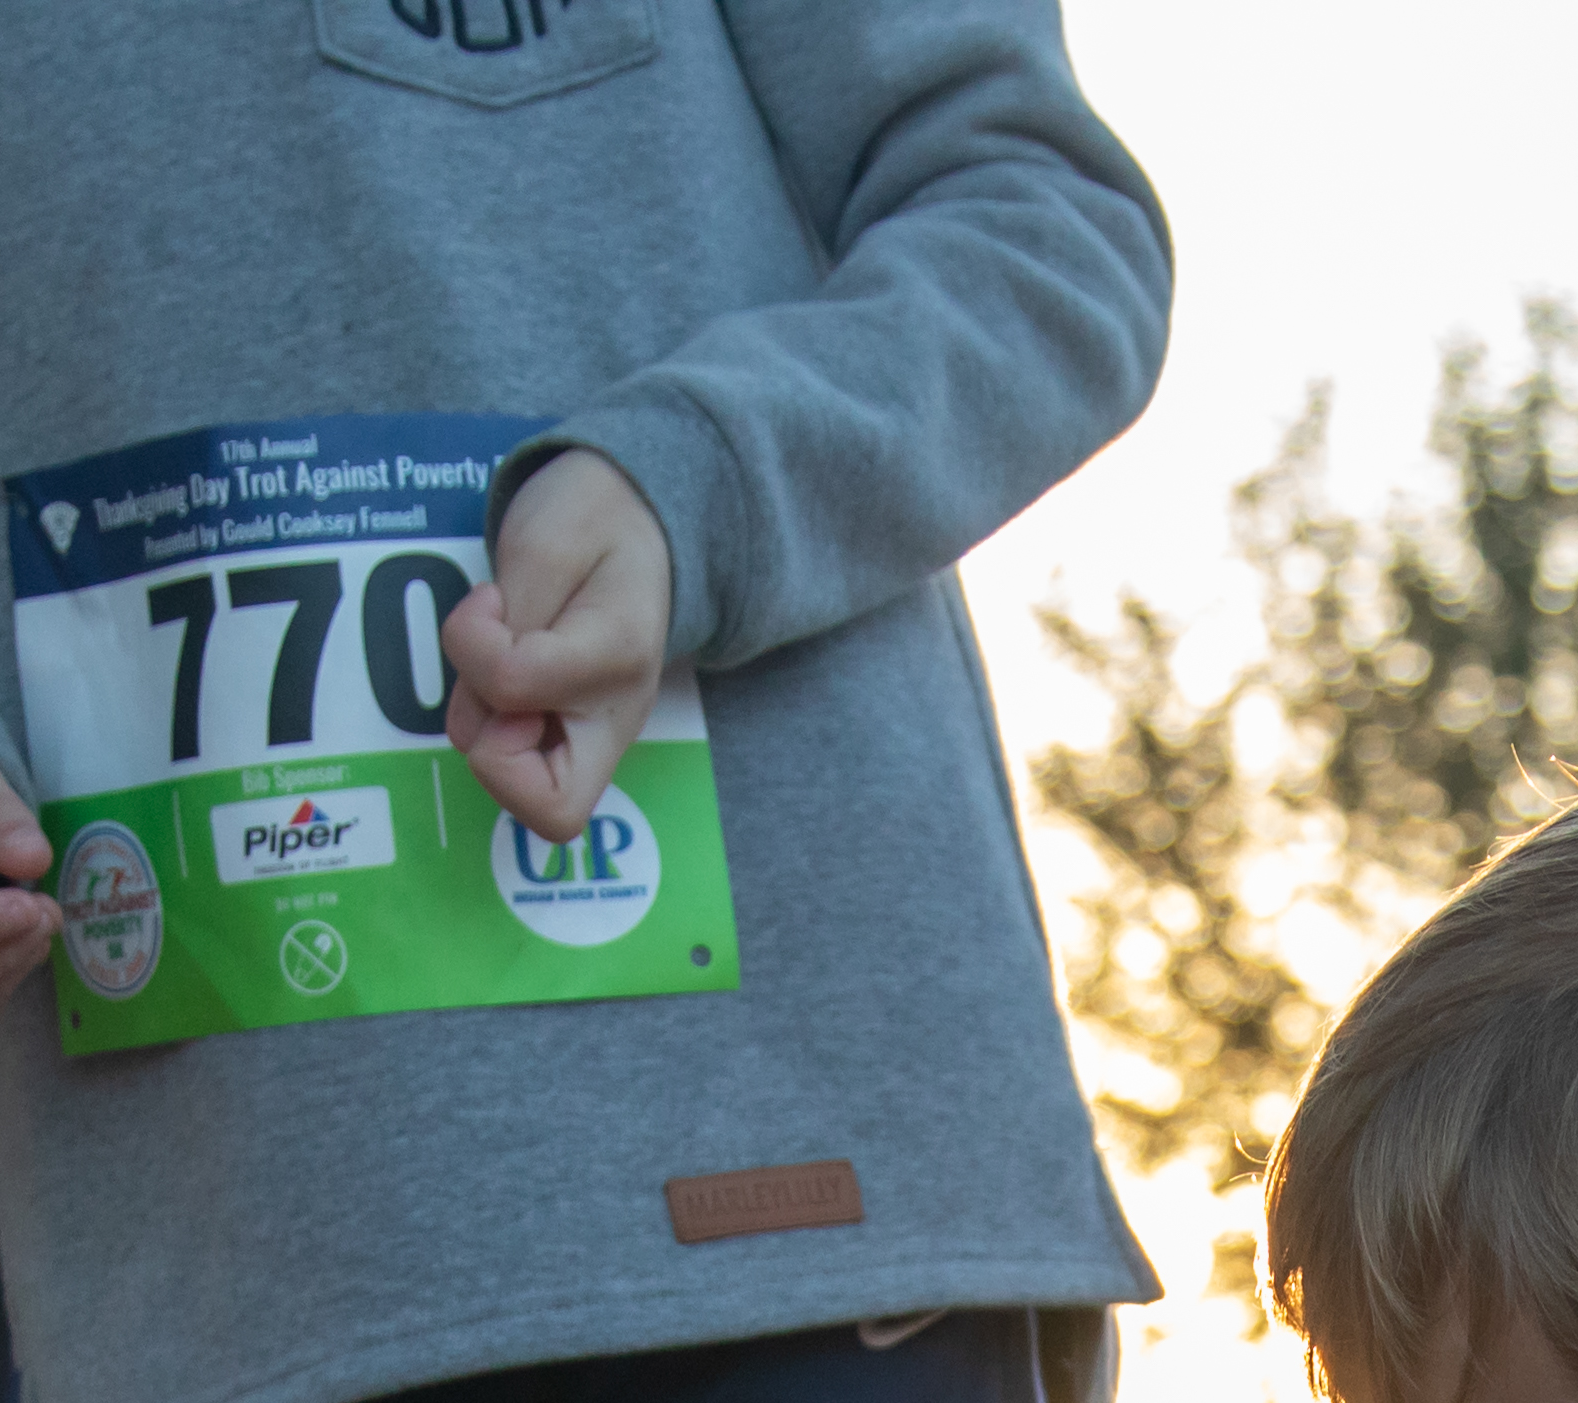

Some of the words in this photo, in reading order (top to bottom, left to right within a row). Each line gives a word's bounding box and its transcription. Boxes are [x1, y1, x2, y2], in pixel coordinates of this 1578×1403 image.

[220, 439, 257, 463] 17th
[260, 433, 318, 460] Annual
[93, 482, 189, 533] Thanksgiving
[190, 473, 231, 508] Day
[234, 464, 289, 499] Trot
[295, 459, 390, 501] Against
[395, 455, 489, 493] Poverty
[198, 523, 220, 551] by
[222, 514, 275, 546] Gould
[278, 510, 356, 540] Cooksey
[359, 503, 428, 532] Fennell
[148, 551, 472, 764] 770
[241, 768, 270, 793] Bib
[244, 822, 353, 859] Piper
[507, 814, 635, 886] UP
